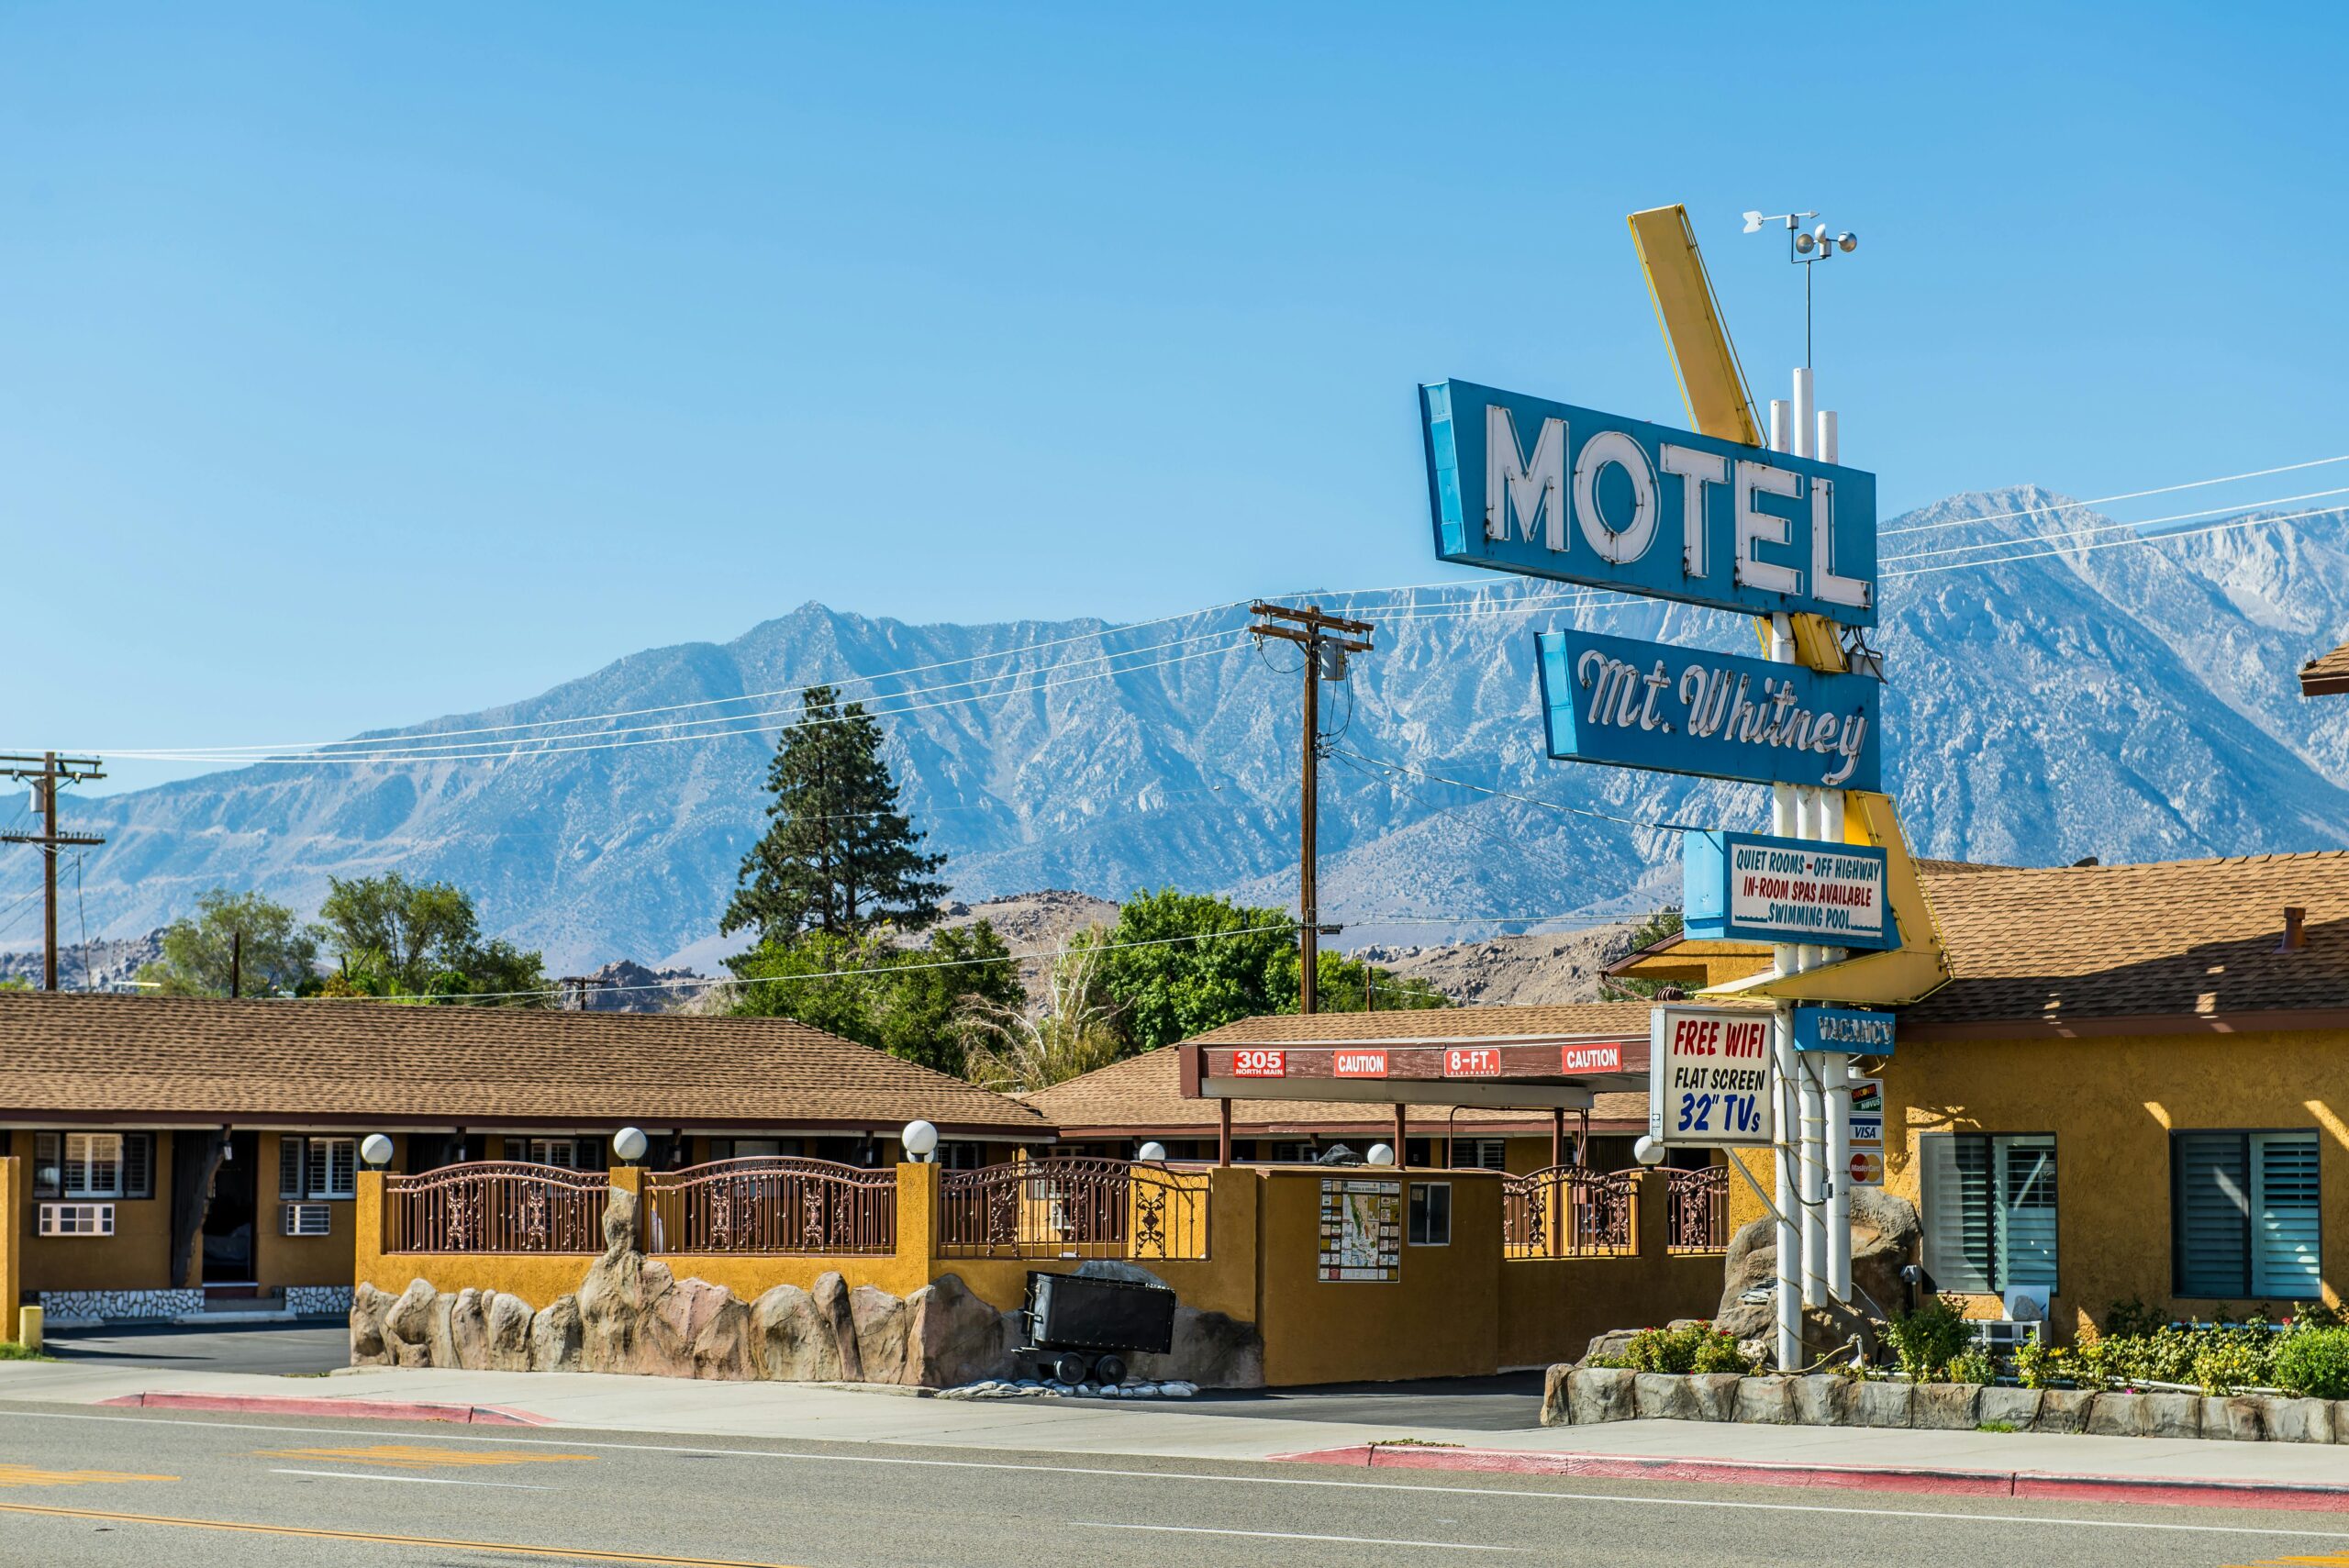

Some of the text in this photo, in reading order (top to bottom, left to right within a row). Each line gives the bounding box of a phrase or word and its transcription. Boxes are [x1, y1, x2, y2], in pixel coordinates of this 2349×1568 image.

[1486, 404, 1873, 608] MOTEL
[1578, 650, 1868, 785] Mt. Whitney
[1736, 849, 1767, 871] QUIET
[1769, 851, 1805, 874] ROOMS
[1813, 856, 1833, 878] OFF
[1835, 858, 1881, 882] HIGHWAY
[1743, 876, 1873, 907] IN-ROOM SPAS AVAILABLE
[1767, 902, 1852, 929] SWIMMING POOL
[1674, 1019, 1766, 1059] FREE WIFI
[1817, 1016, 1892, 1045] VACANCY
[1237, 1051, 1281, 1069] 305
[1338, 1055, 1385, 1073] CAUTION
[1451, 1051, 1494, 1071] 8-FT.
[1566, 1049, 1618, 1069] CAUTION
[1675, 1067, 1766, 1091] FLAT SCREEN
[1677, 1092, 1761, 1133] 32" TVs
[1854, 1126, 1876, 1139] VISA
[1851, 1164, 1881, 1173] MasterCard
